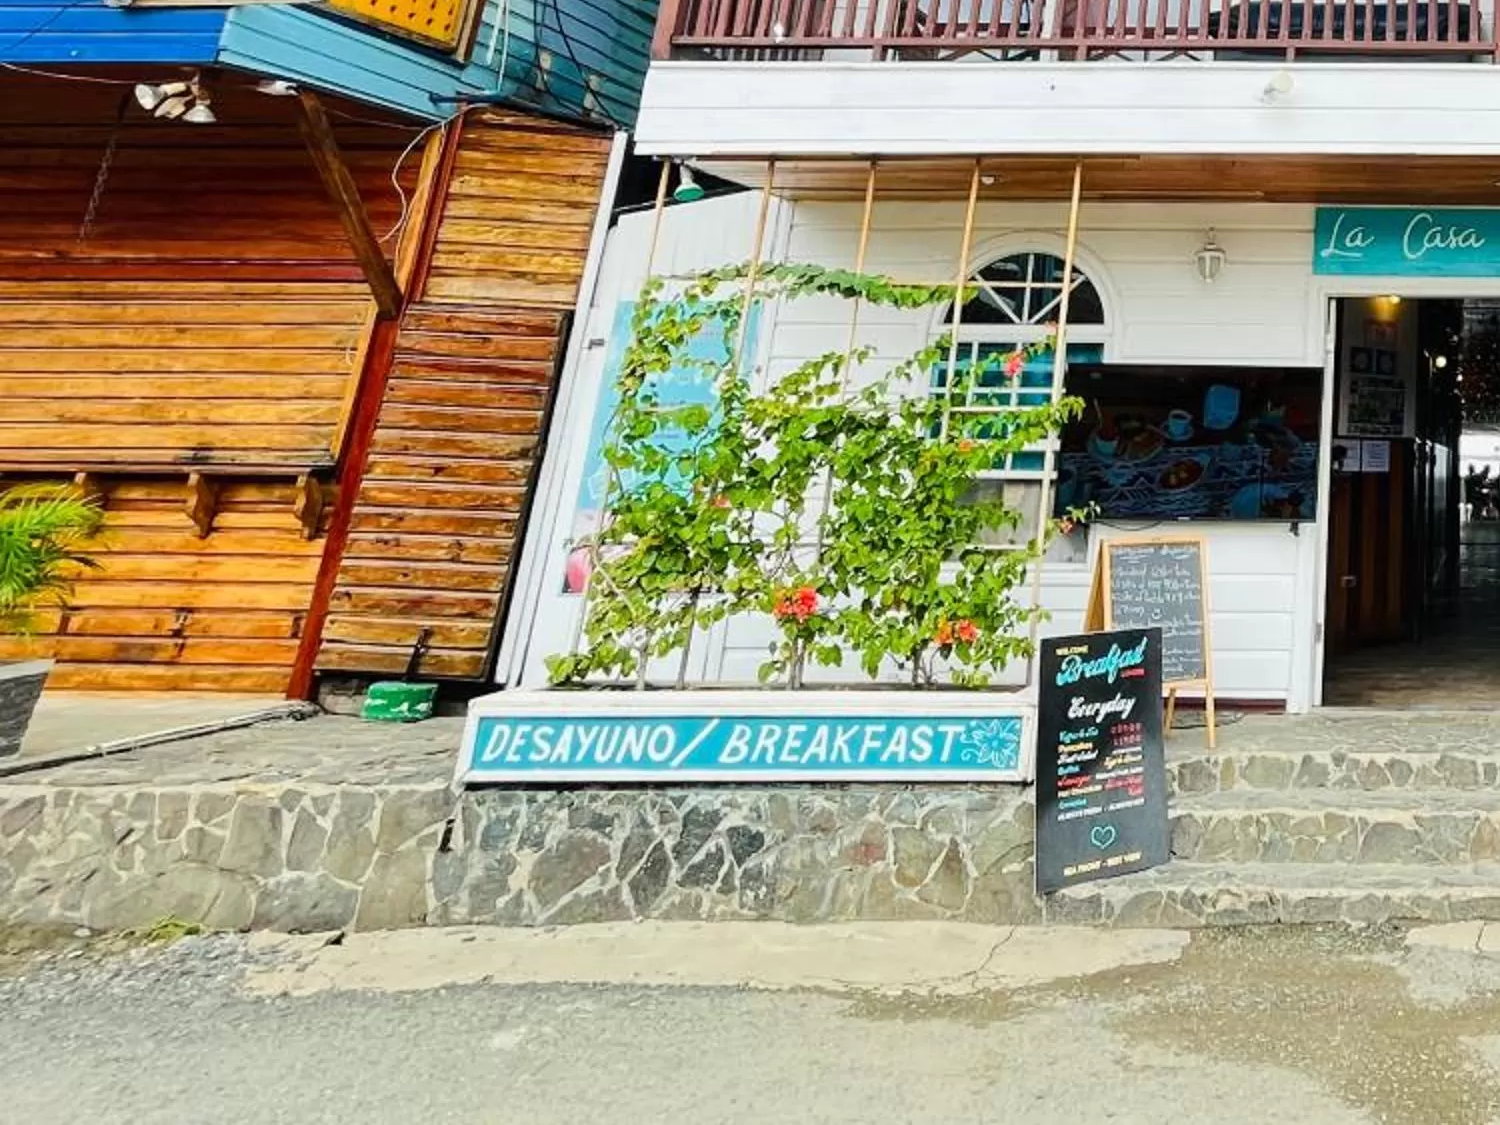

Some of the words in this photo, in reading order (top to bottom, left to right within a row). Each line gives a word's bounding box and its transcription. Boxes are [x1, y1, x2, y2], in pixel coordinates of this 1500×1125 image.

[1320, 212, 1375, 258] La
[1403, 212, 1486, 260] Casa
[1068, 692, 1137, 724] Everyday
[718, 723, 966, 765] BREAKFAST
